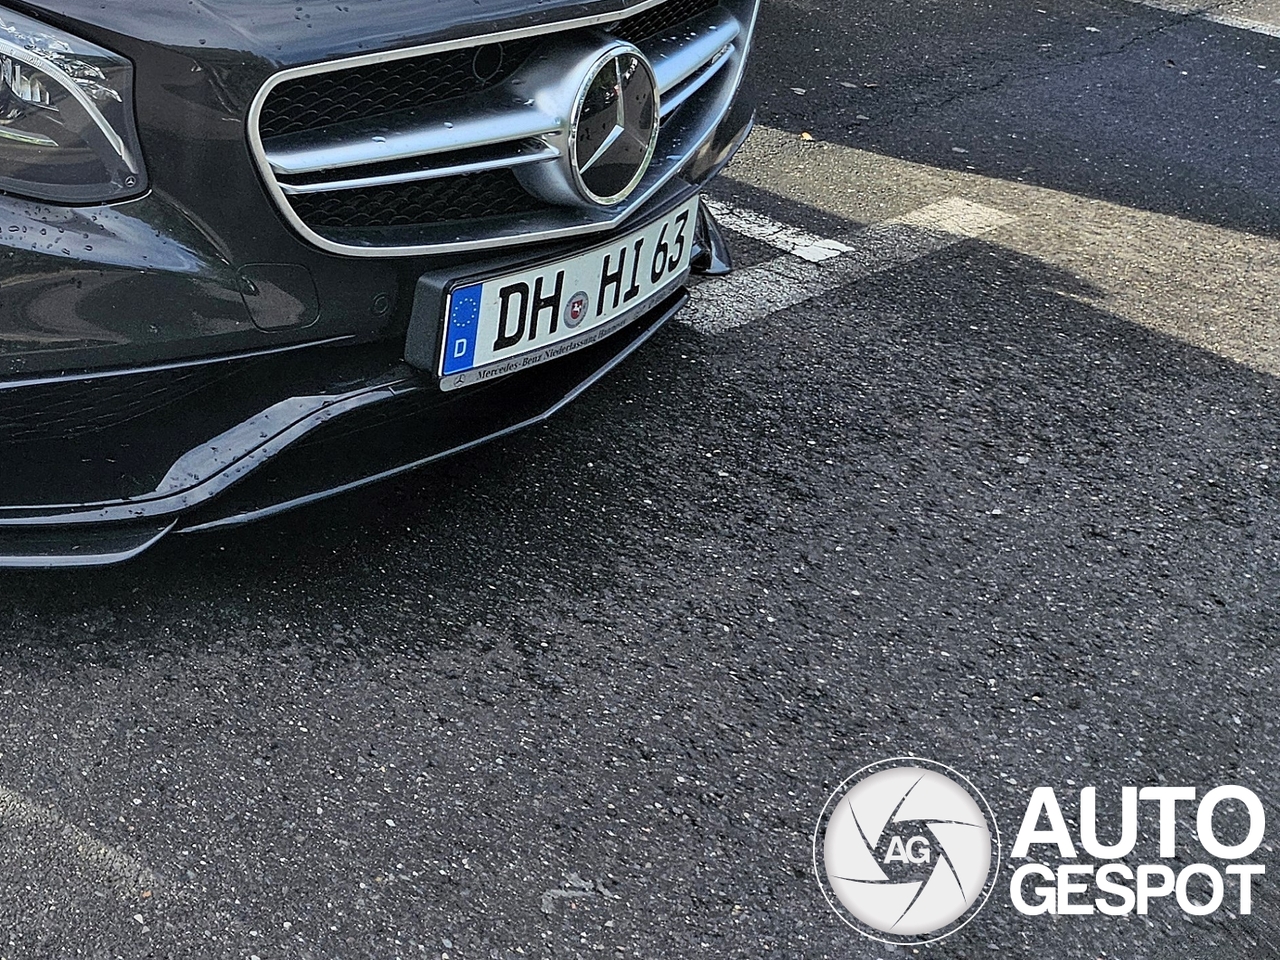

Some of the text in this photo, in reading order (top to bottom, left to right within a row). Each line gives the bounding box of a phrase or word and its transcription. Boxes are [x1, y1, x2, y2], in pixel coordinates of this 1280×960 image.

[453, 338, 467, 358] D
[493, 270, 565, 352] DH
[596, 238, 644, 317] HI
[651, 208, 689, 284] 63
[477, 354, 542, 380] Mercedes-Benz
[544, 335, 597, 360] Niederlassung
